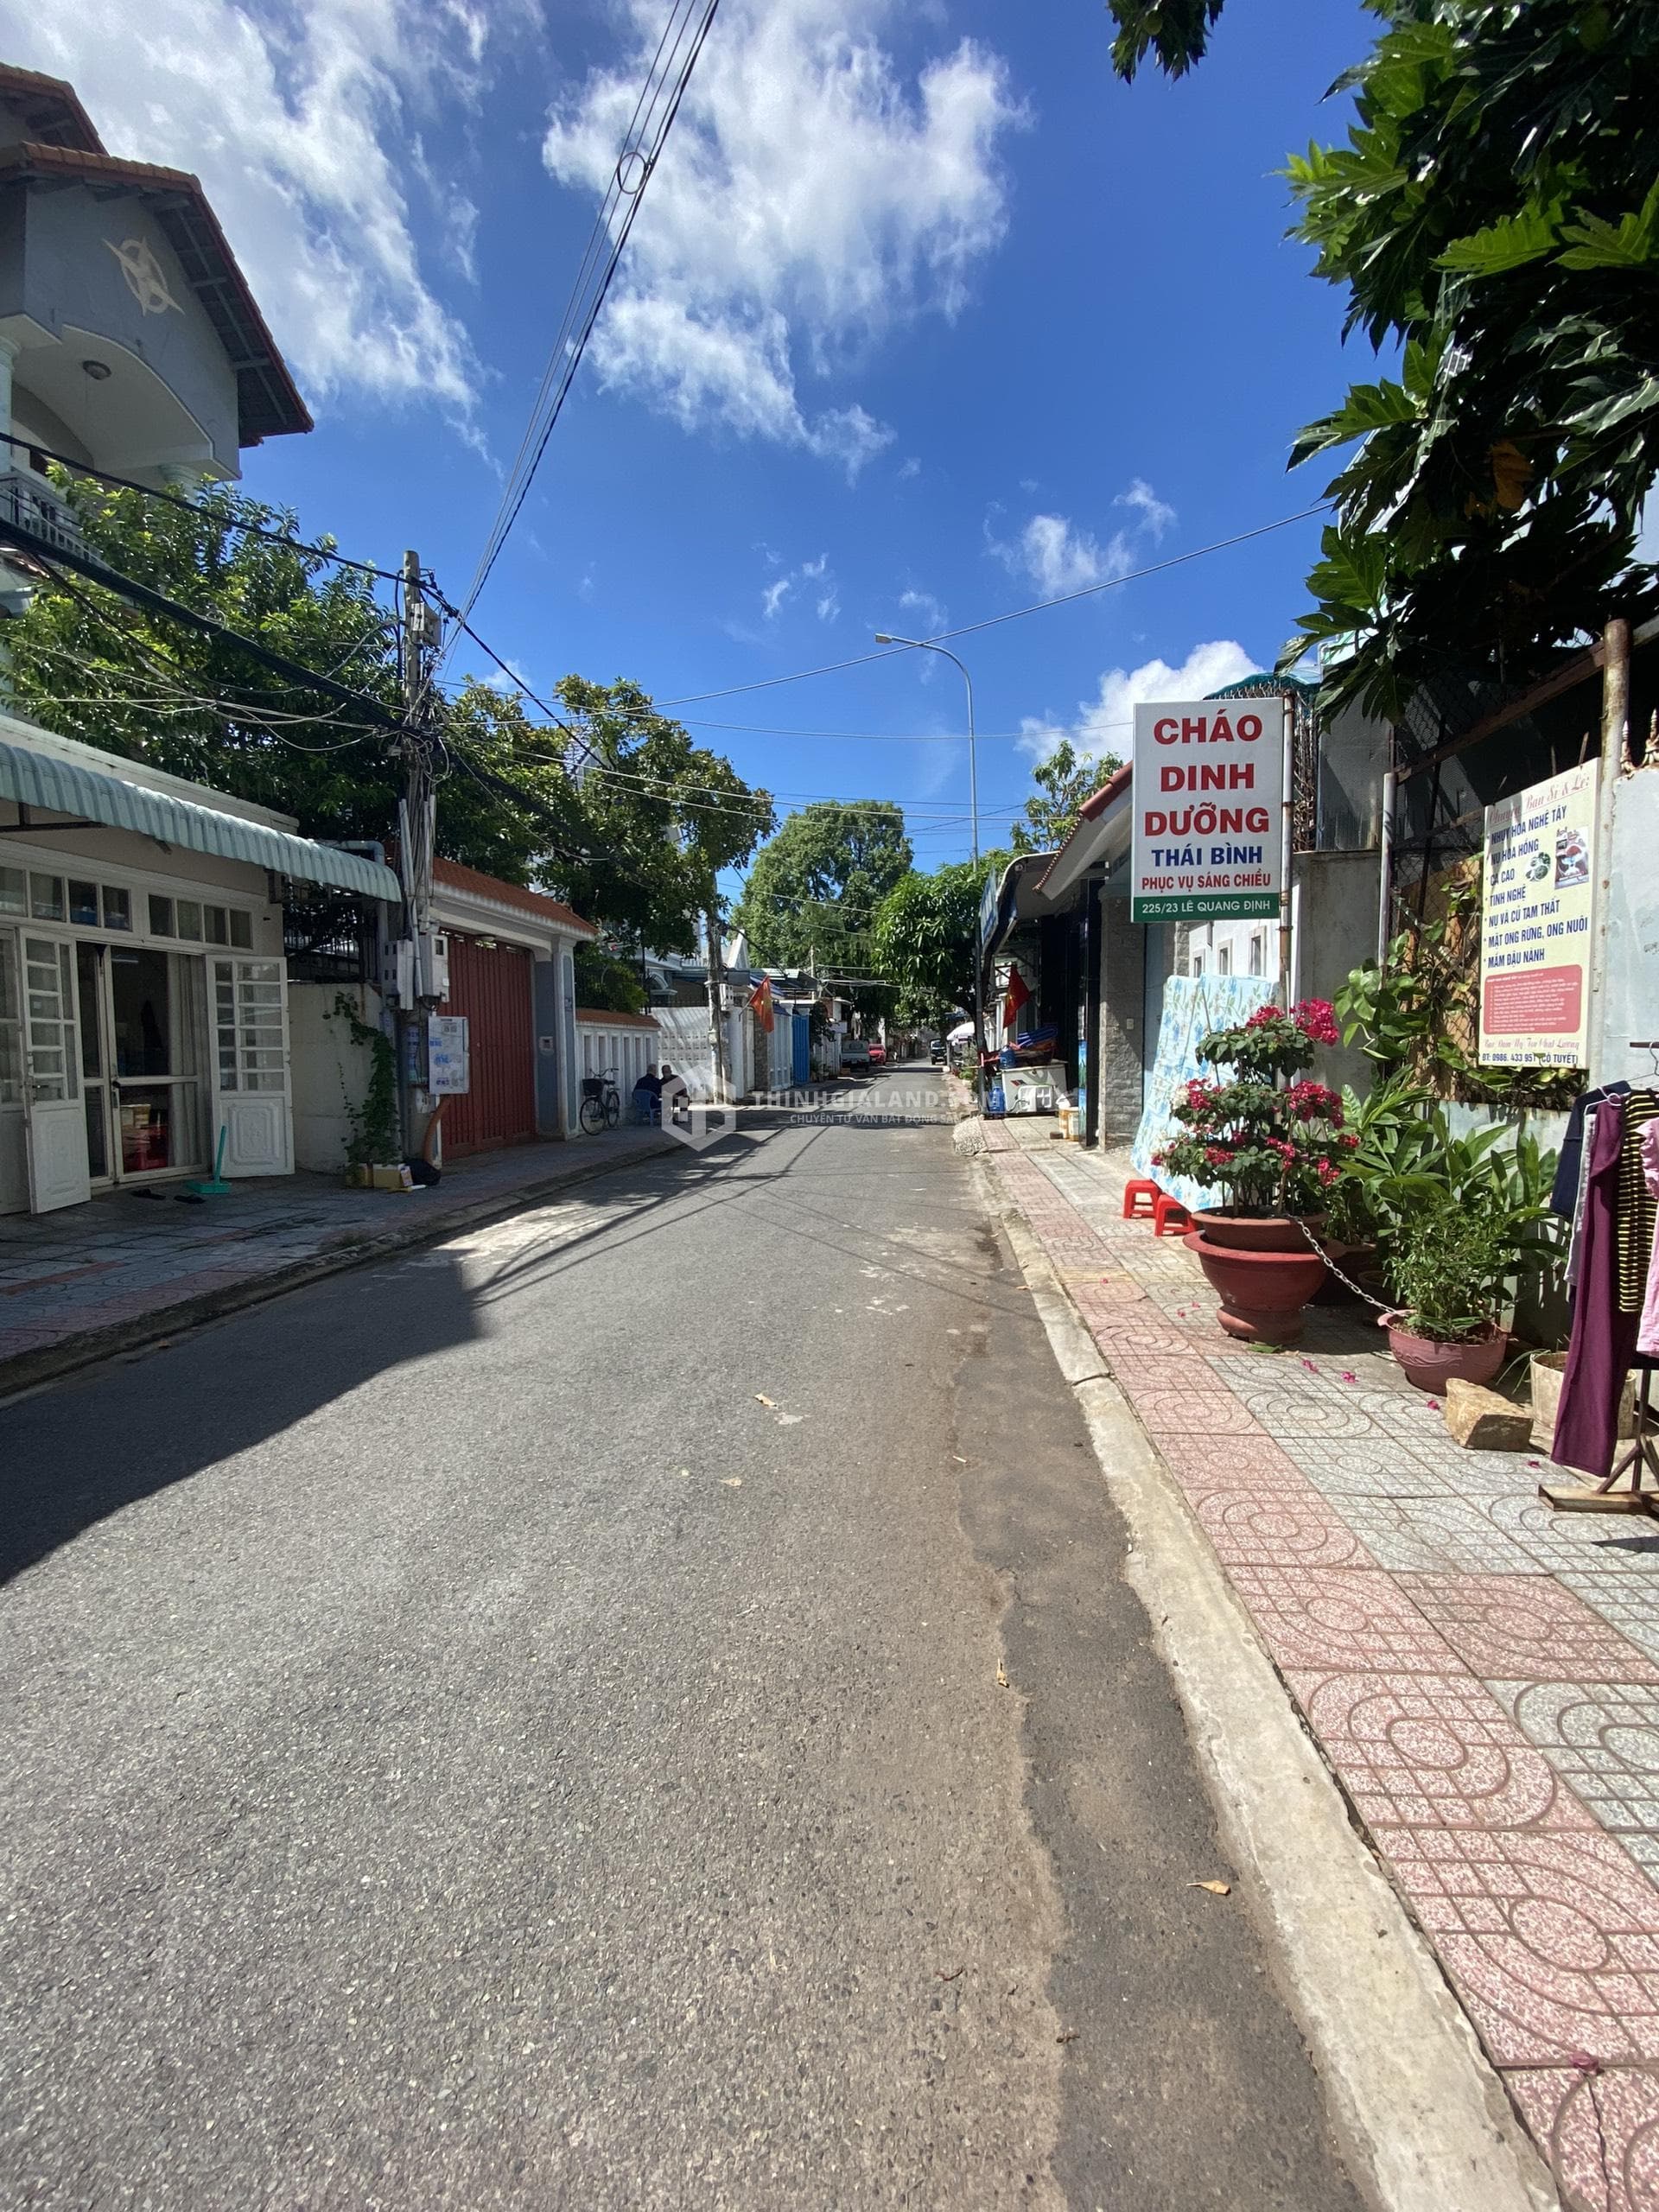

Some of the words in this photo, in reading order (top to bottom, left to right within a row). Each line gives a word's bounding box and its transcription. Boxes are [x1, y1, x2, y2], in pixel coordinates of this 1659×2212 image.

[1154, 709, 1263, 745] CHÁO
[1160, 763, 1255, 792] DINH
[1144, 802, 1269, 836] DƯỠNG
[1511, 822, 1526, 837] HOA
[1528, 810, 1549, 830] NGHỆ
[1552, 804, 1567, 823] TÂY
[1151, 843, 1202, 867] THÁI
[1211, 842, 1262, 865] BÌNH
[1502, 847, 1516, 861] HOA
[1141, 876, 1173, 893] PHỤC
[1178, 875, 1193, 892] VỤ
[1198, 872, 1230, 887] SÁNG
[1234, 868, 1271, 887] CHIỀU
[1490, 873, 1498, 887] CA
[1501, 868, 1515, 883] CAO
[1142, 902, 1179, 914] 225/23
[1181, 899, 1194, 912] LÊ
[1197, 901, 1240, 912] QUANG
[1243, 900, 1270, 912] ĐỊNH
[1490, 892, 1504, 906] TINH
[1506, 884, 1526, 902] NGHỆ
[1489, 915, 1498, 929] NỤ
[1522, 905, 1538, 919] TAM
[1504, 931, 1519, 945] ONG
[1547, 922, 1564, 938] ONG
[1566, 915, 1588, 934] NUÔI
